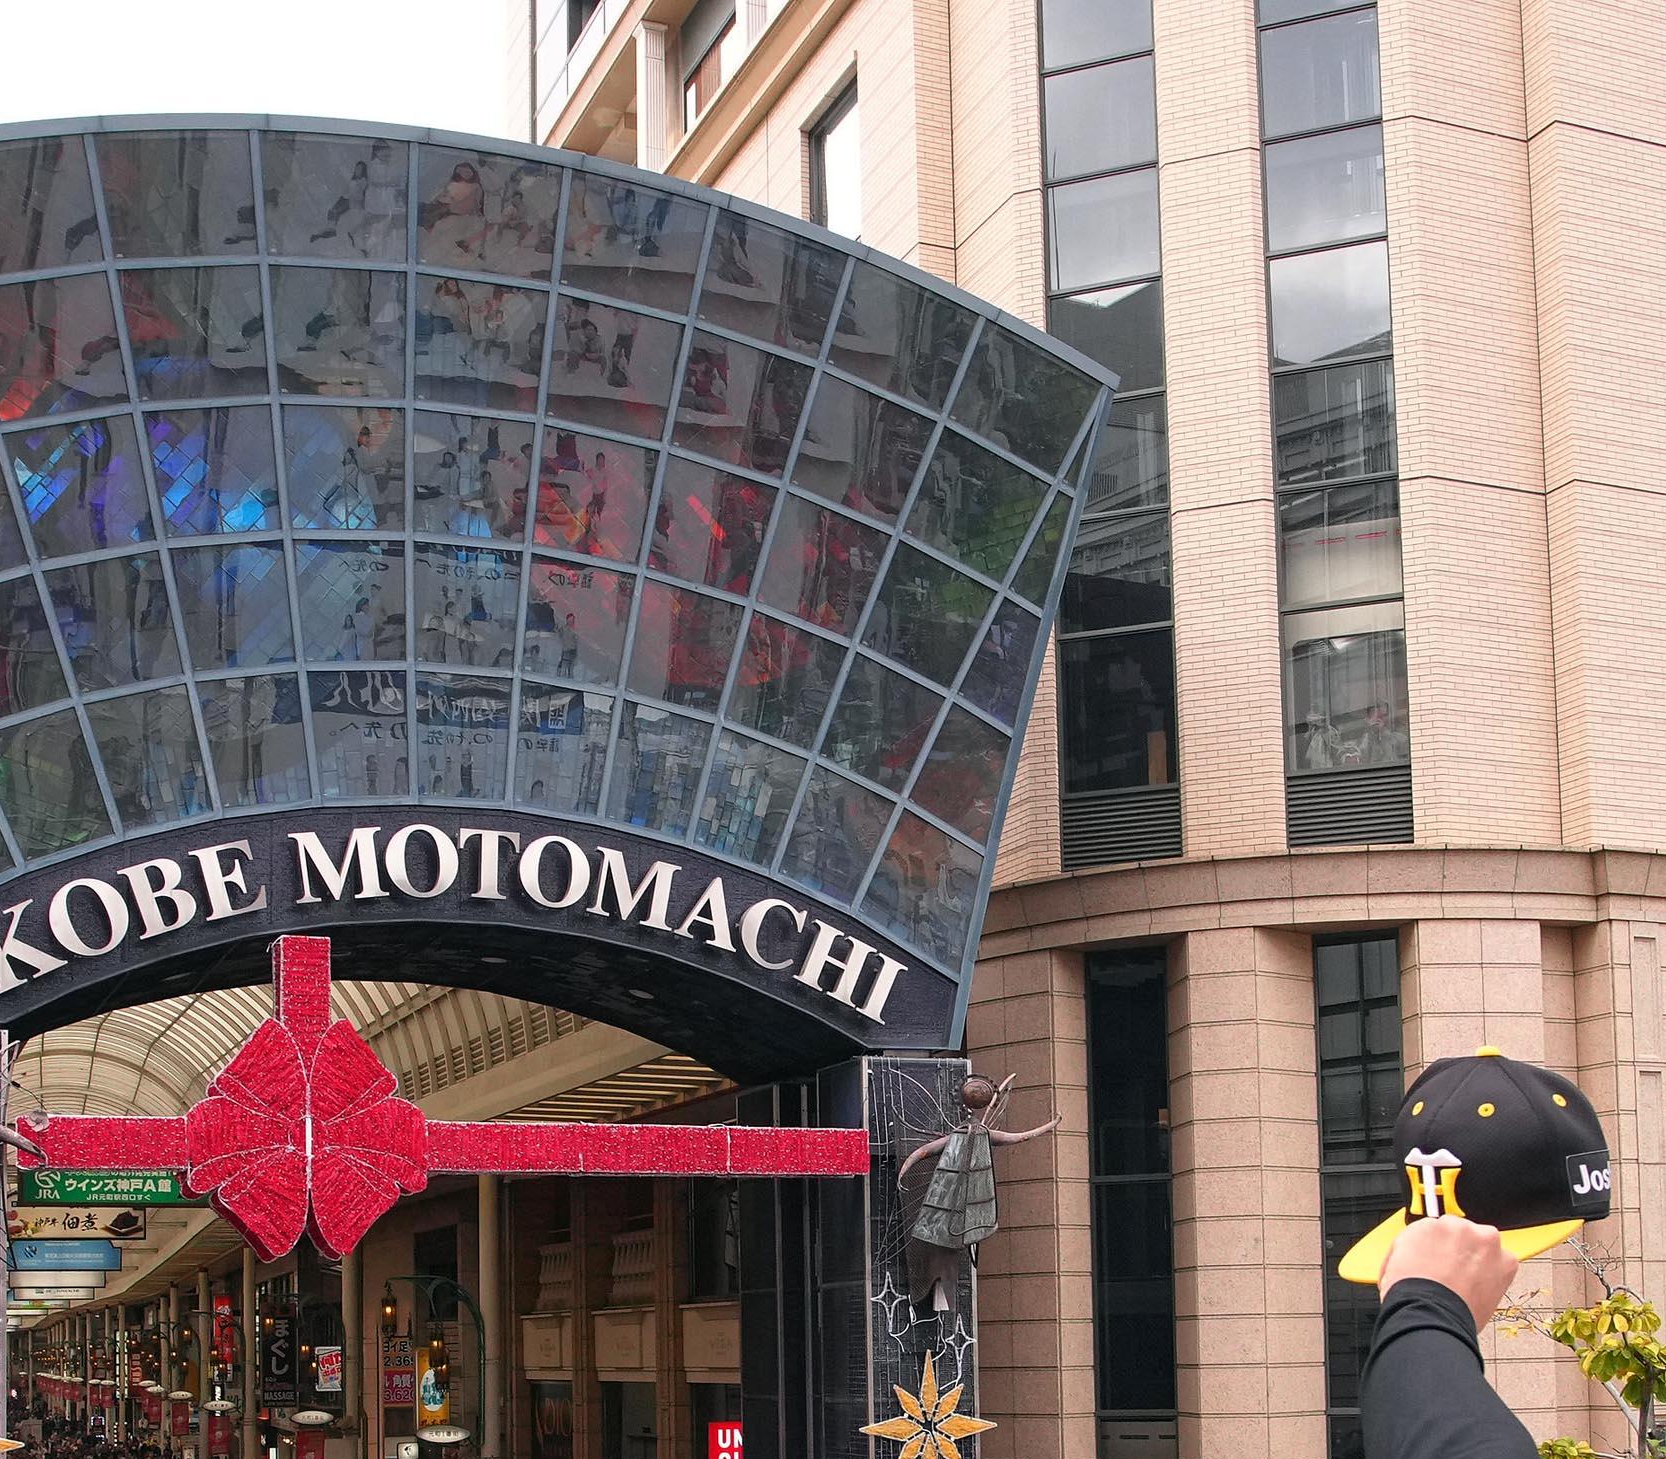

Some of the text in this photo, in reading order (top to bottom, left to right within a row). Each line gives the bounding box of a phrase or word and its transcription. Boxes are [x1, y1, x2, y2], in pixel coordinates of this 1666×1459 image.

[288, 823, 910, 1026] MOTOMACHI
[64, 1178, 172, 1193] ウインズ神戸A館
[1573, 1164, 1611, 1196] Jos
[35, 1189, 60, 1200] JRA
[61, 1212, 99, 1232] 佃煮
[717, 1428, 743, 1448] UN
